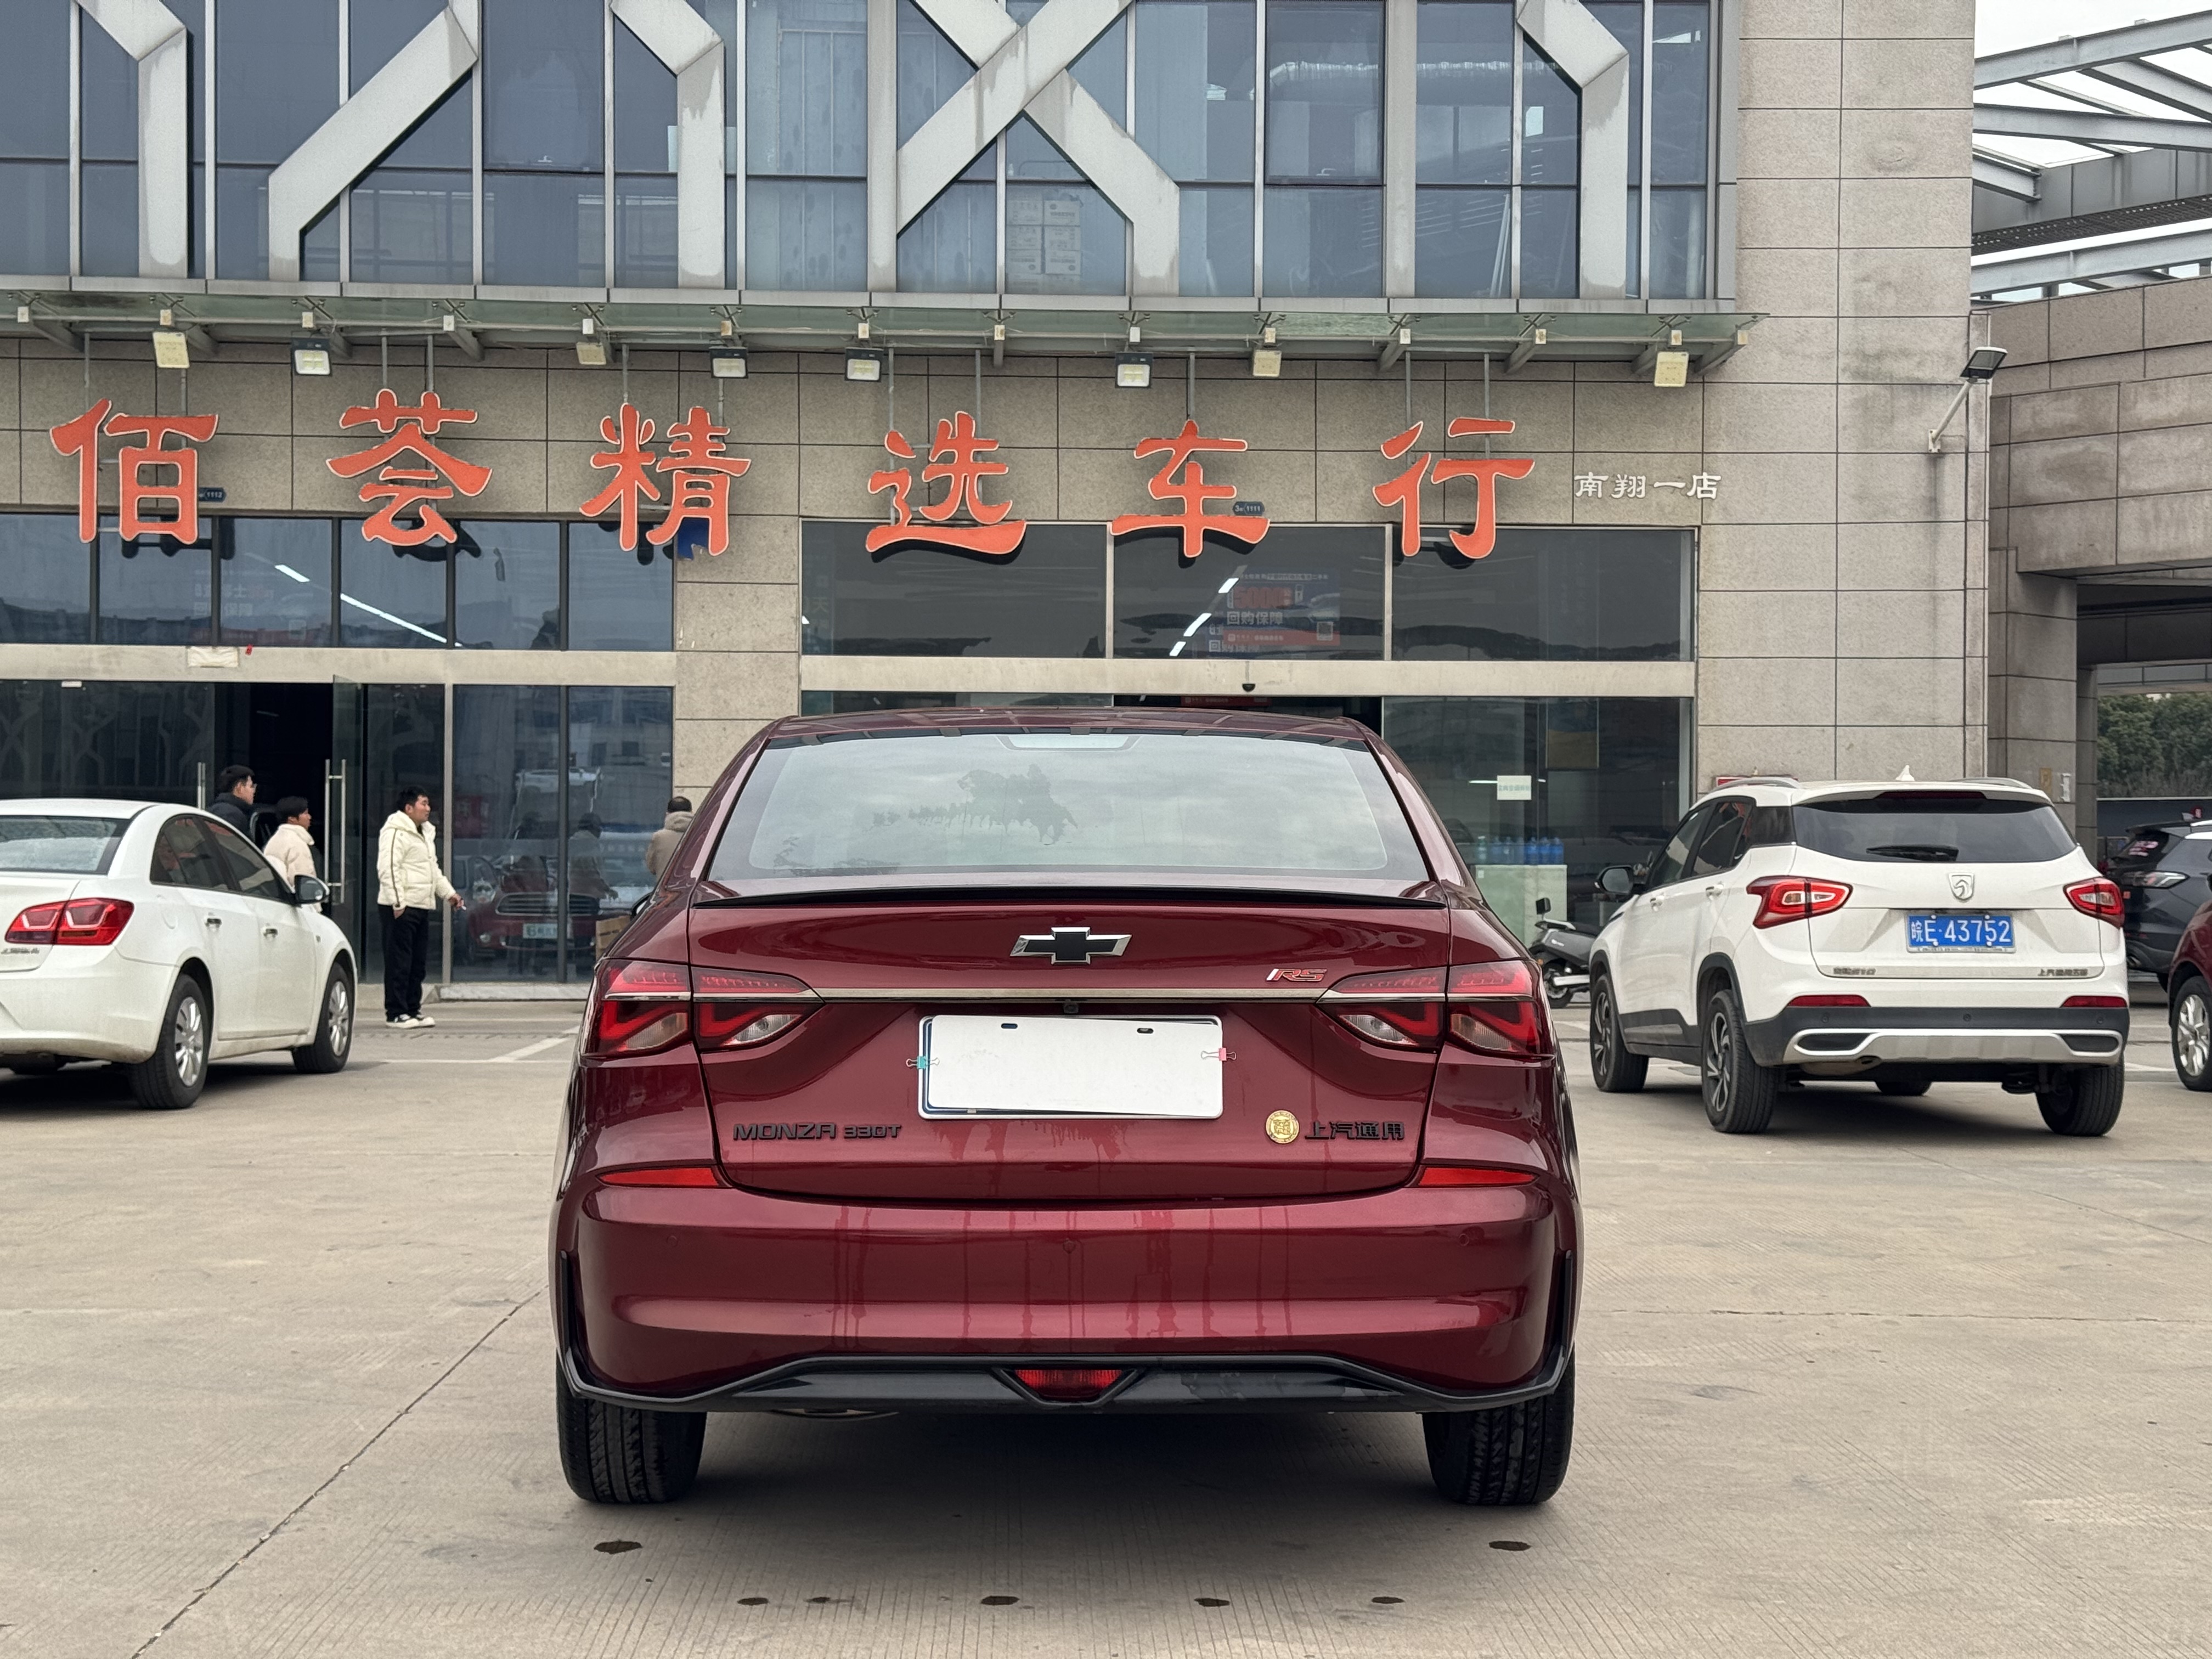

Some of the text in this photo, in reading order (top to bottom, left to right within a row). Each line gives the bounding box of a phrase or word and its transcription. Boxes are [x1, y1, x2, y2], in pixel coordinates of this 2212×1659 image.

[50, 389, 1536, 559] 佰荟精选车行
[1574, 471, 1722, 499] 南翔一店
[1227, 611, 1283, 625] 回购保障
[1266, 968, 1327, 982] RS
[733, 1123, 902, 1141] MONZA 330T
[1305, 1121, 1406, 1141] 上汽通用
